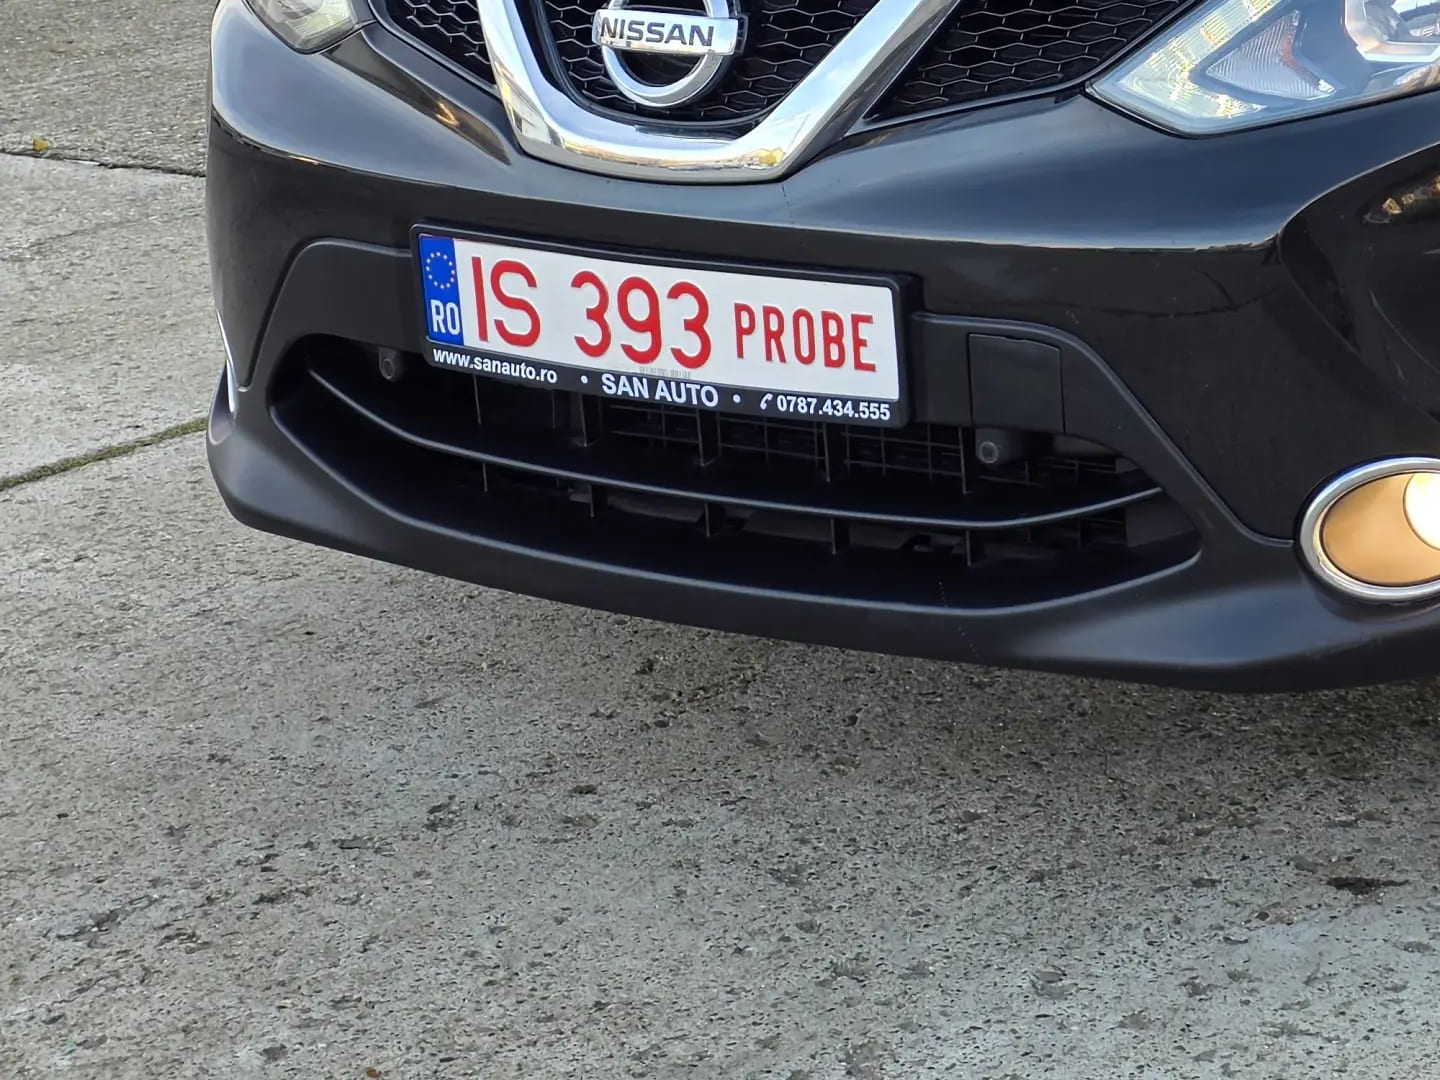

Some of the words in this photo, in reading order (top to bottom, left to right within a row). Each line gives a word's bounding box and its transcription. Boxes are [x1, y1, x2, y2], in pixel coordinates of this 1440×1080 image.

[600, 16, 714, 47] NISSAN
[430, 299, 460, 335] RO
[472, 256, 541, 347] IS
[571, 270, 712, 369] 393
[734, 302, 876, 372] PROBE
[433, 348, 558, 383] www.sanauto.ro
[601, 373, 649, 399] SAN
[655, 379, 719, 407] AUTO
[776, 394, 891, 421] 0787.434.555
